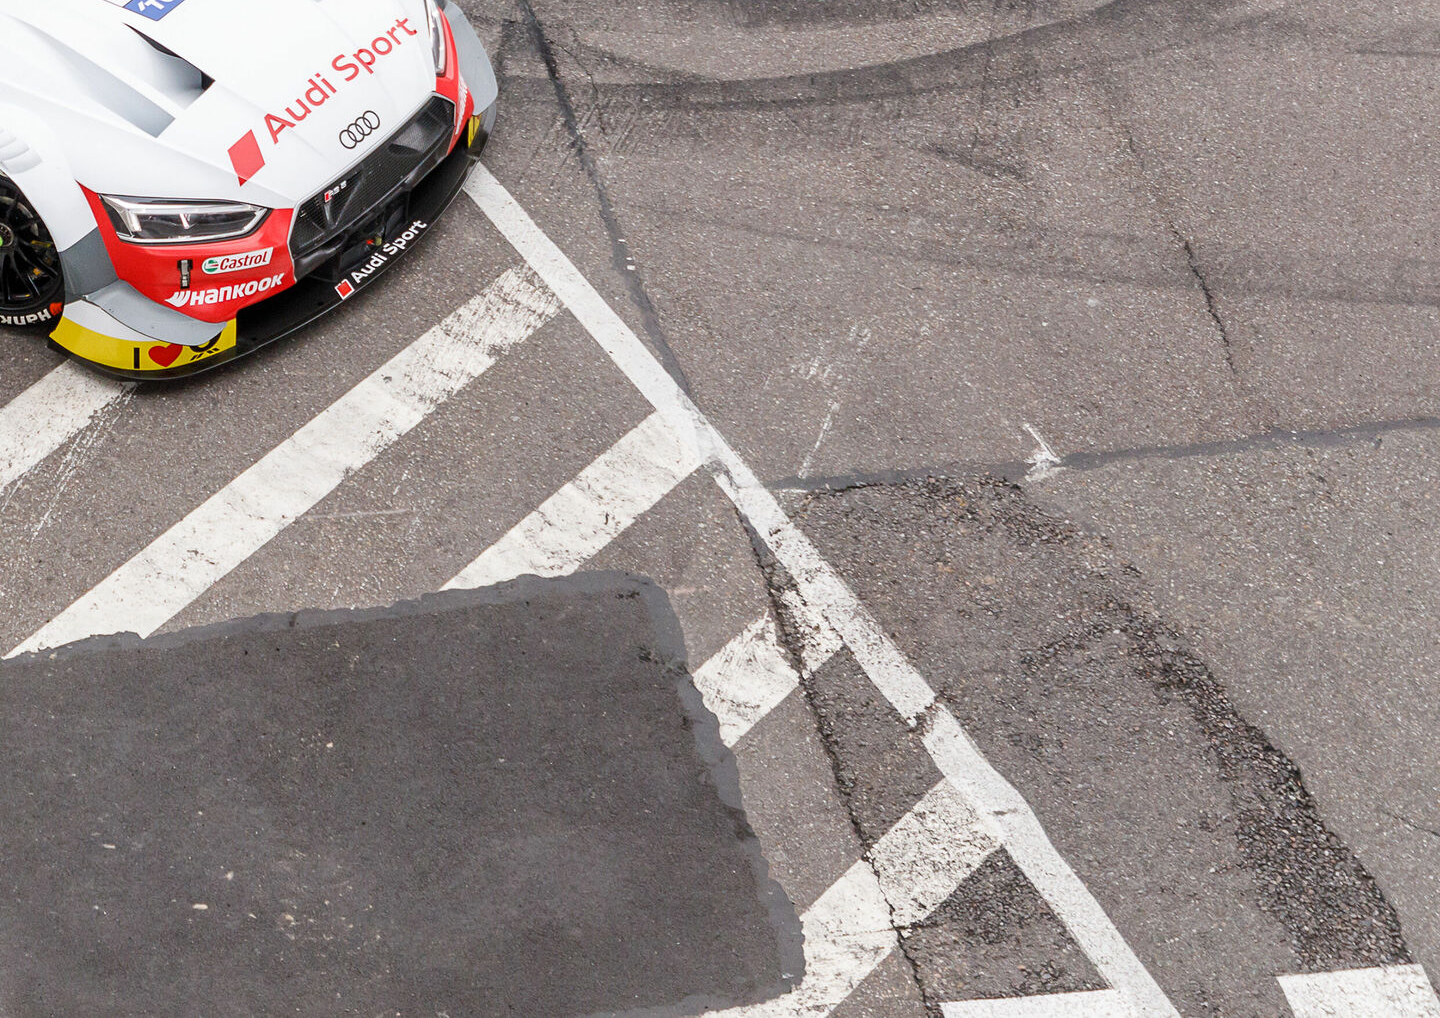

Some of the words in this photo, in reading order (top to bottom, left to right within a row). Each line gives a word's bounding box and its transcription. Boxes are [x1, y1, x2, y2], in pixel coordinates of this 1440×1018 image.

[264, 72, 337, 145] Audi
[331, 18, 418, 82] Sport
[220, 251, 267, 271] Castrol
[350, 252, 388, 284] Audi
[382, 220, 427, 255] Sport
